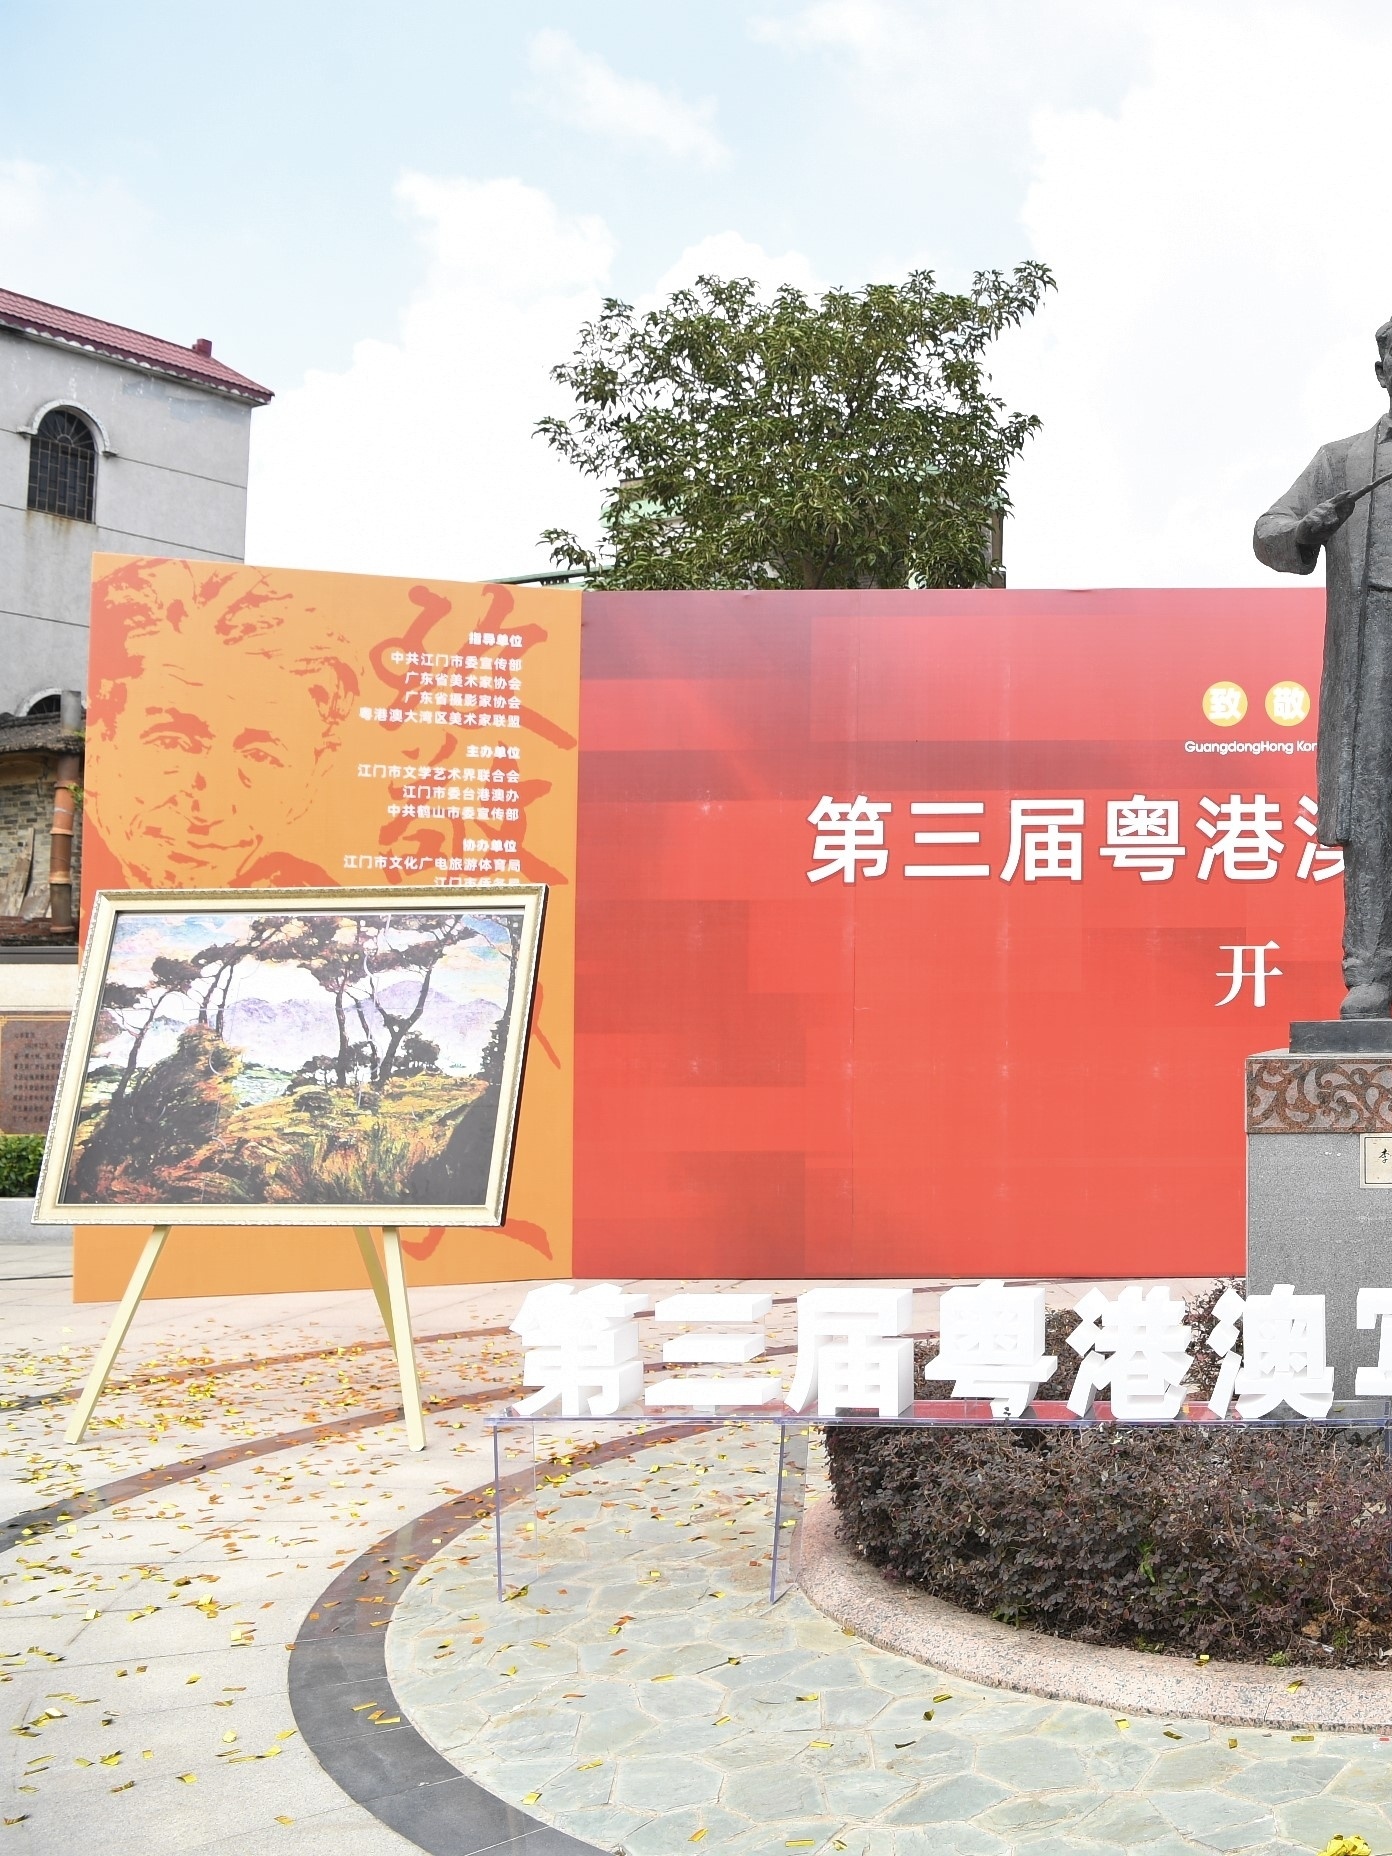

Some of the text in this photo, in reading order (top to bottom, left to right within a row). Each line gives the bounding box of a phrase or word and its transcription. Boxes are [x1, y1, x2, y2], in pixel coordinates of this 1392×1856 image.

[468, 632, 522, 647] 指导单位
[391, 651, 522, 671] 中共江门市委宣传部
[405, 672, 522, 690] 广东省美术家协会
[404, 691, 521, 709] 广东省摄影家协会
[1209, 687, 1305, 720] 致敬
[359, 707, 521, 728] 粤港澳大湾区美术家联盟
[466, 745, 520, 759] 主办单位
[1184, 740, 1294, 755] GuangdongHong
[1297, 740, 1317, 752] Kon
[357, 764, 520, 783] 江门市文学艺术界联合会
[403, 785, 519, 803] 江门市委台港澳办
[387, 804, 519, 821] 中共鹤山市委宣传部
[463, 838, 517, 853] 协办单位
[343, 855, 521, 872] 江门市文化广电旅游体育局
